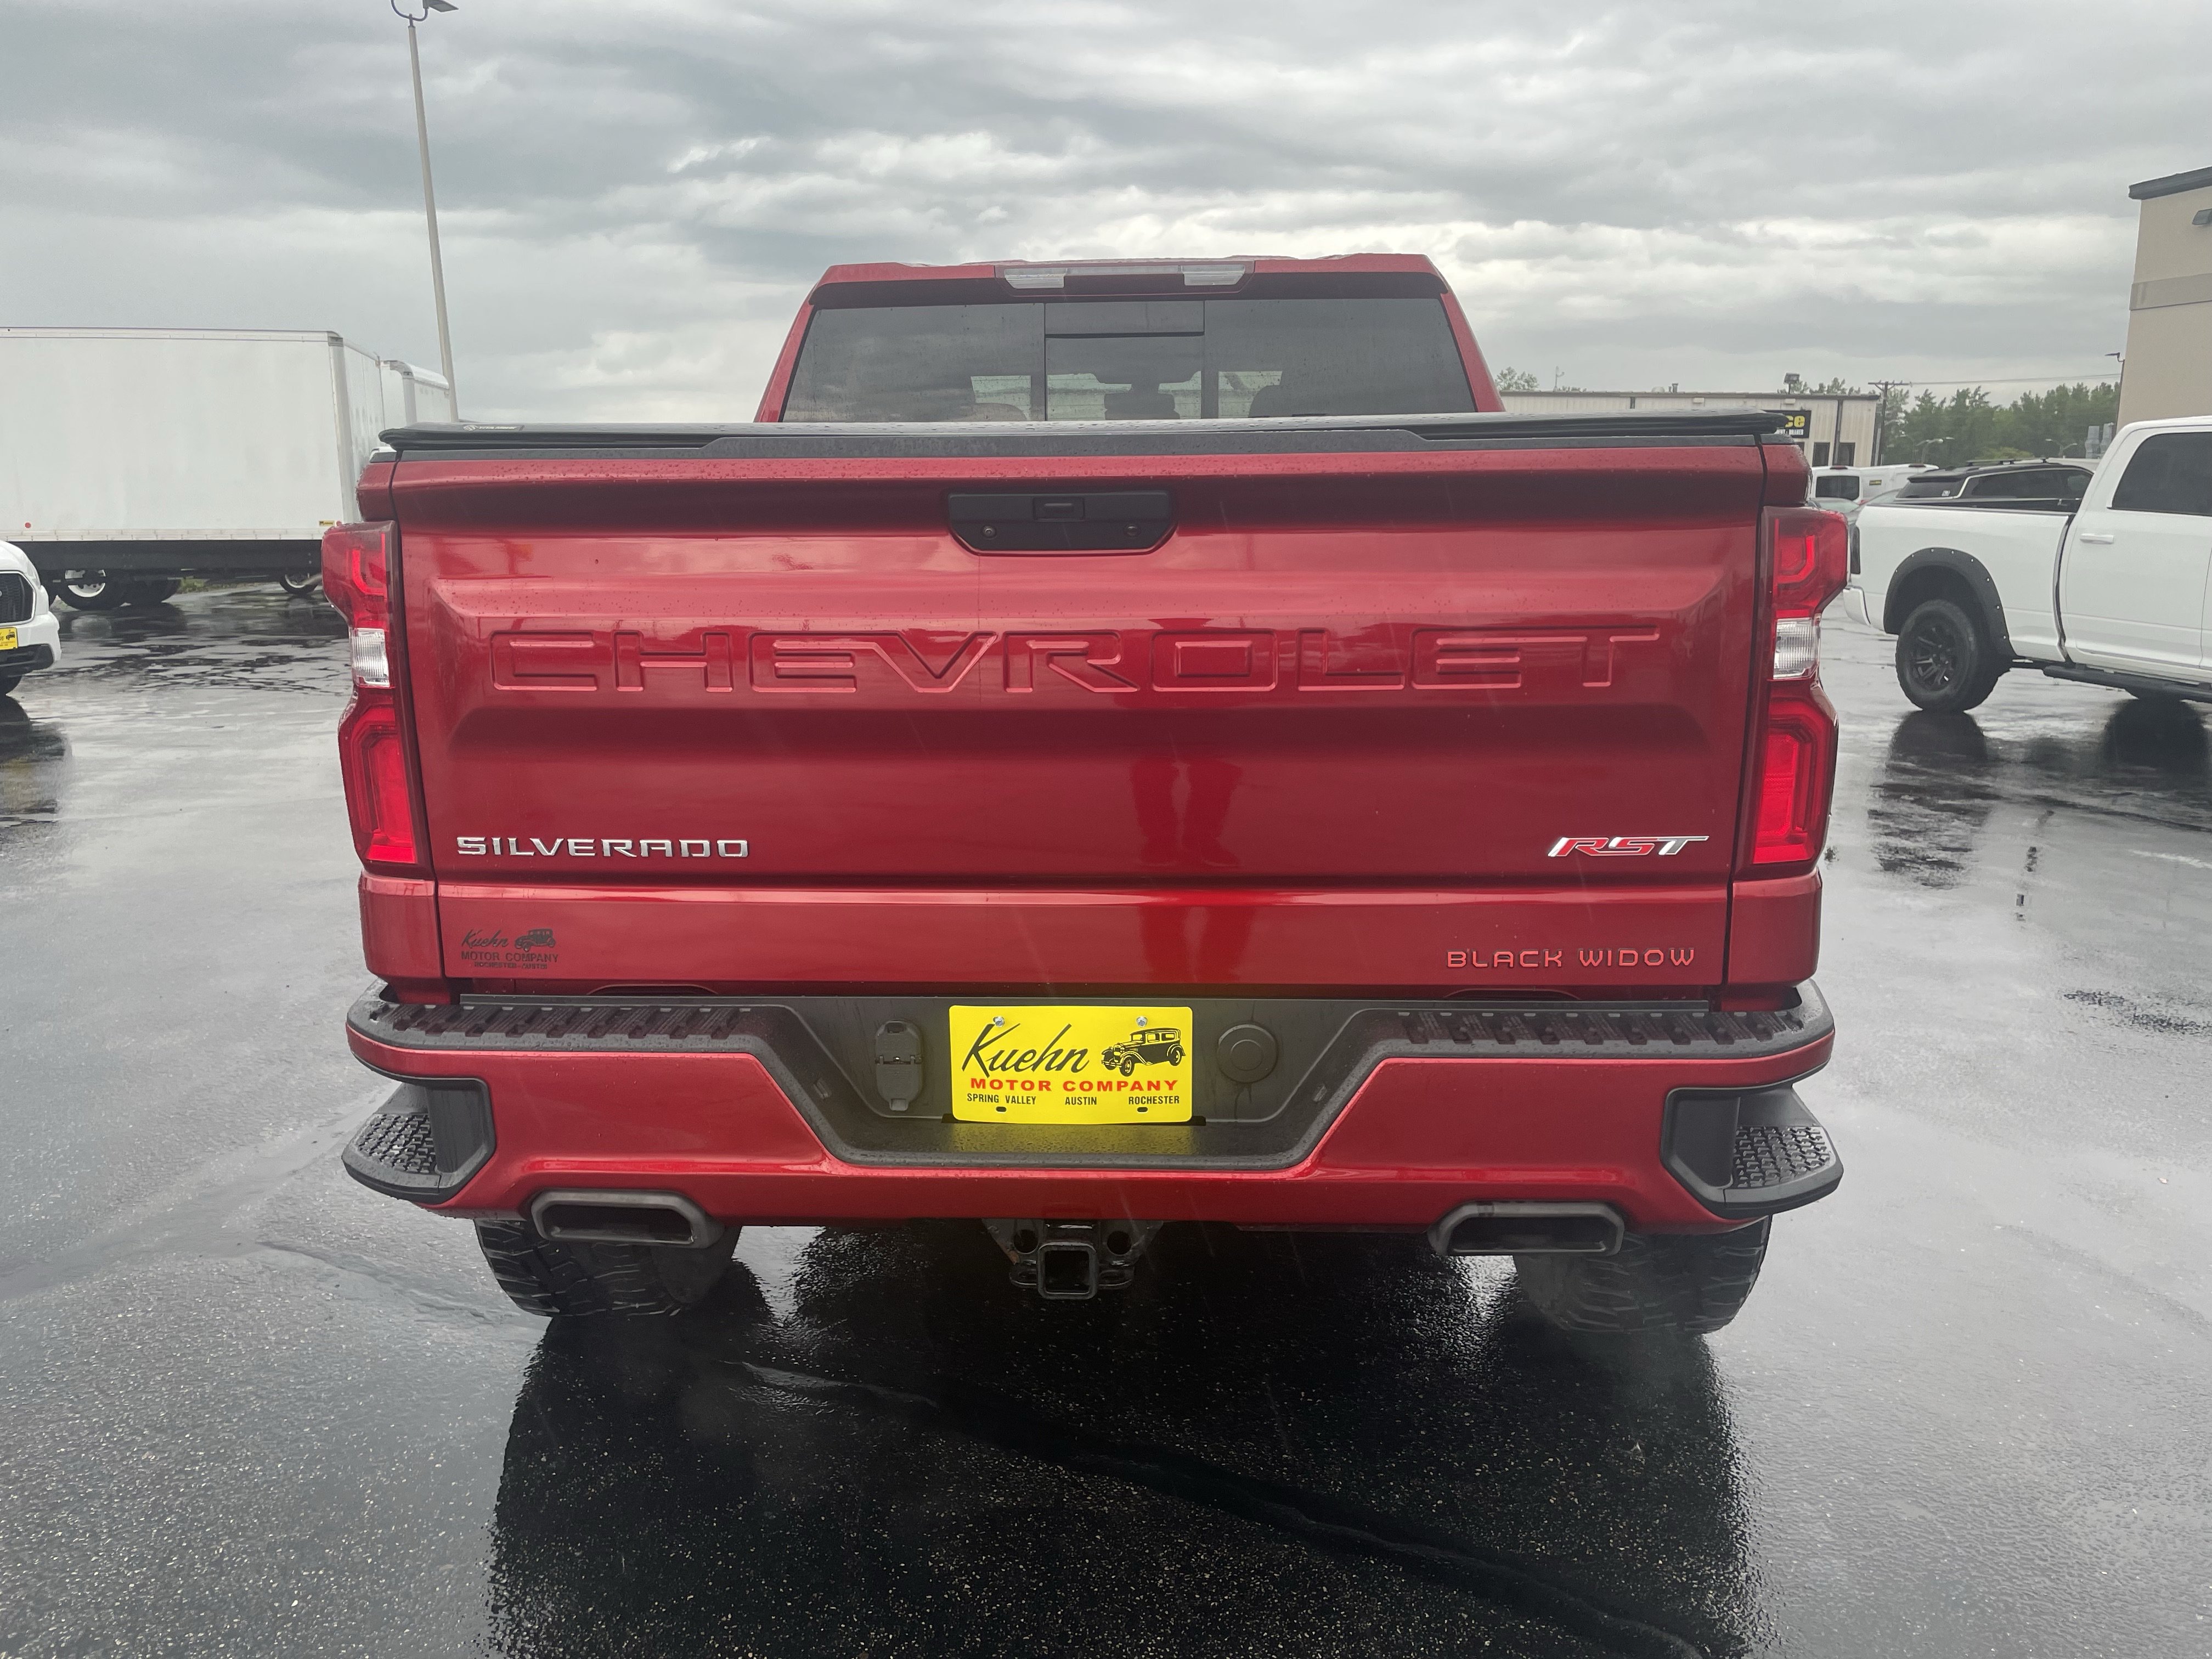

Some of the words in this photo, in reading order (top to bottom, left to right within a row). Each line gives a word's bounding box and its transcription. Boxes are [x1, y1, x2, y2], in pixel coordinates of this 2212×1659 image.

[490, 624, 1660, 696] CHEVROLET
[456, 836, 748, 858] SILVERADO
[1548, 836, 1709, 857] RST
[461, 929, 509, 949] Kuehn
[461, 951, 500, 961] MOTOR
[505, 952, 558, 962] COMPANY
[1447, 949, 1562, 968] BLACK
[1578, 948, 1695, 967] WIDOW
[961, 1023, 1090, 1079] Kuehn
[970, 1078, 1052, 1092] MOTOR
[1063, 1080, 1179, 1092] COMPANY
[967, 1093, 999, 1103] SPRING
[1005, 1094, 1036, 1105] VALLEY
[1065, 1096, 1097, 1105] AUSTIN
[1128, 1095, 1180, 1105] ROCHESTER
